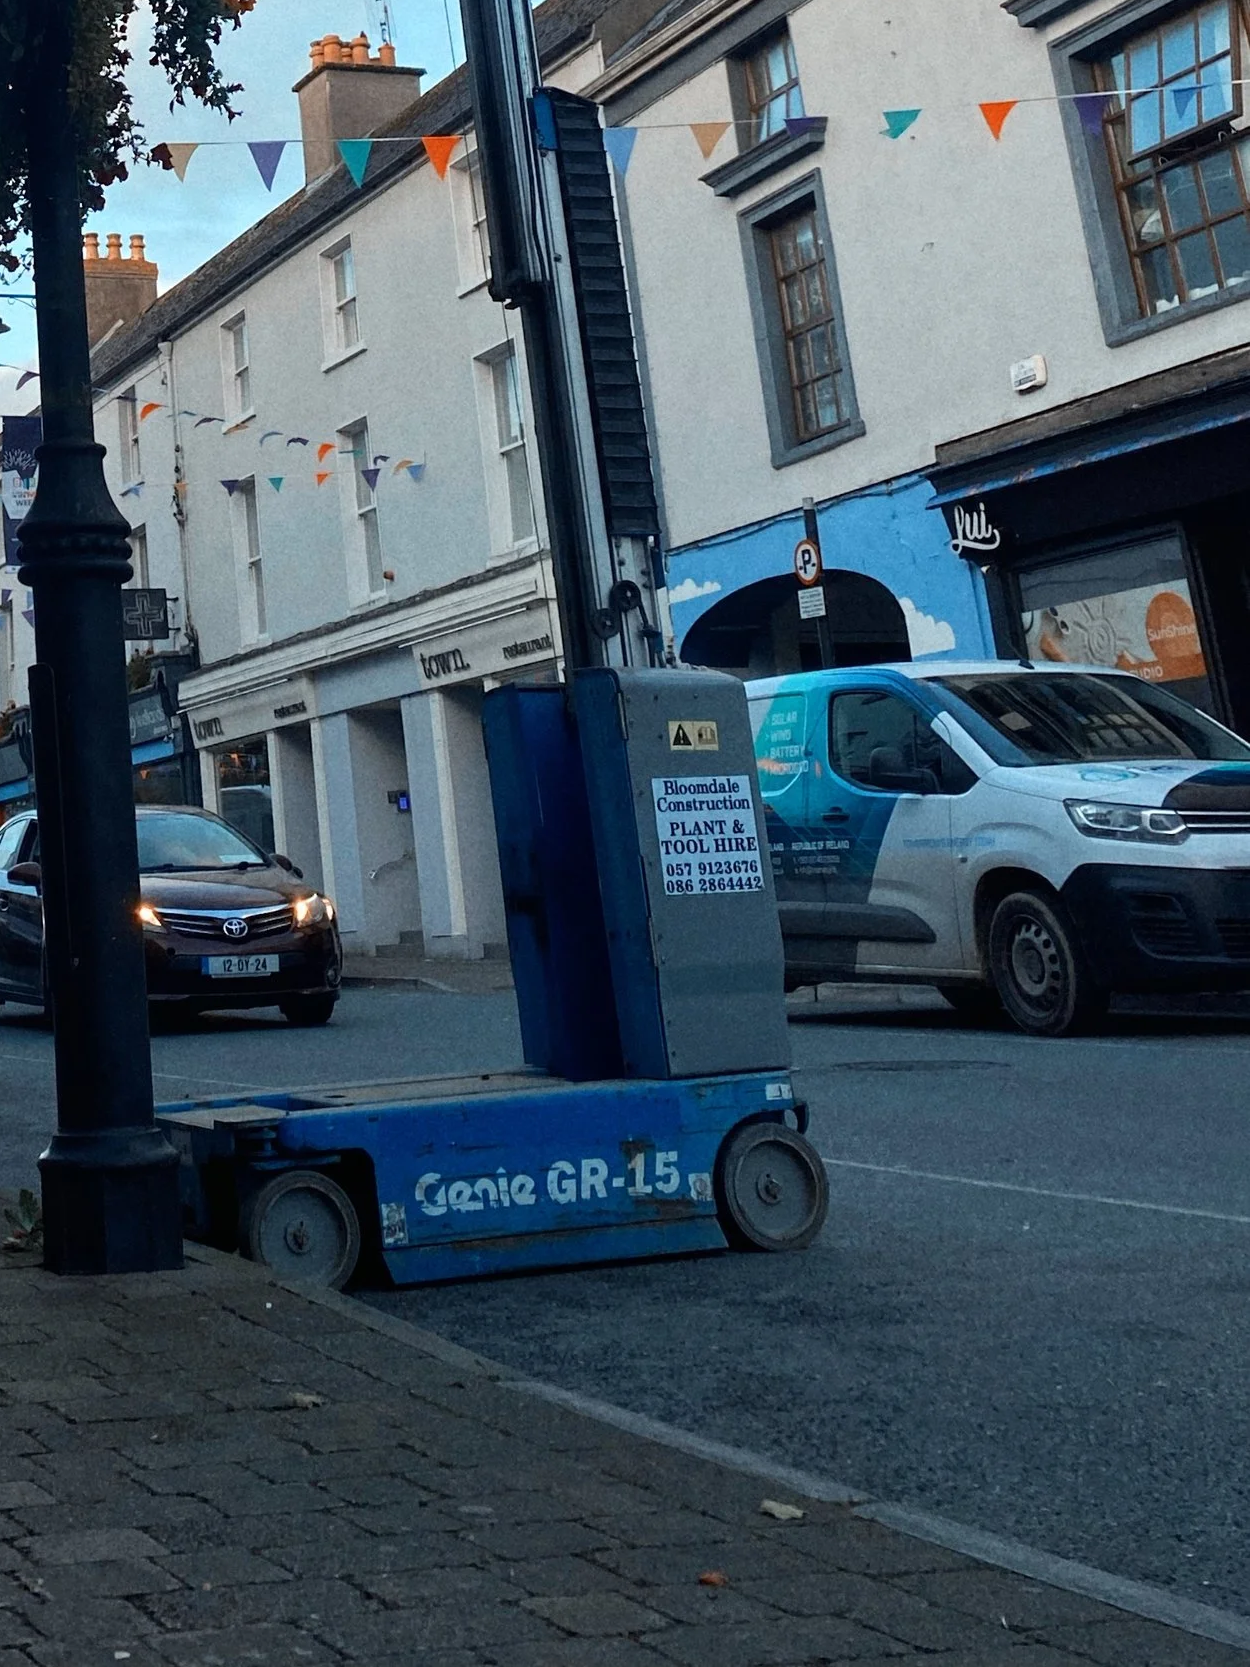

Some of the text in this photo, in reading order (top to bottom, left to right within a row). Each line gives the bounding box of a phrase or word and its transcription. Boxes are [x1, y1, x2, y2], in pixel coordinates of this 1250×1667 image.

[801, 549, 811, 574] P
[502, 633, 552, 659] restaurant
[771, 711, 798, 725] SOLAR
[770, 745, 805, 759] BATTERY
[663, 778, 740, 795] Bloomdale
[657, 796, 750, 812] Construction
[670, 819, 745, 836] PLANT &
[661, 836, 758, 855] TOOL HIRE
[769, 842, 784, 851] LAND
[666, 863, 692, 877] 057
[698, 860, 758, 875] 9123676
[667, 876, 763, 894] 086 2864442
[221, 957, 268, 973] 12-OY-24
[415, 1150, 678, 1216] Genie GR-15
